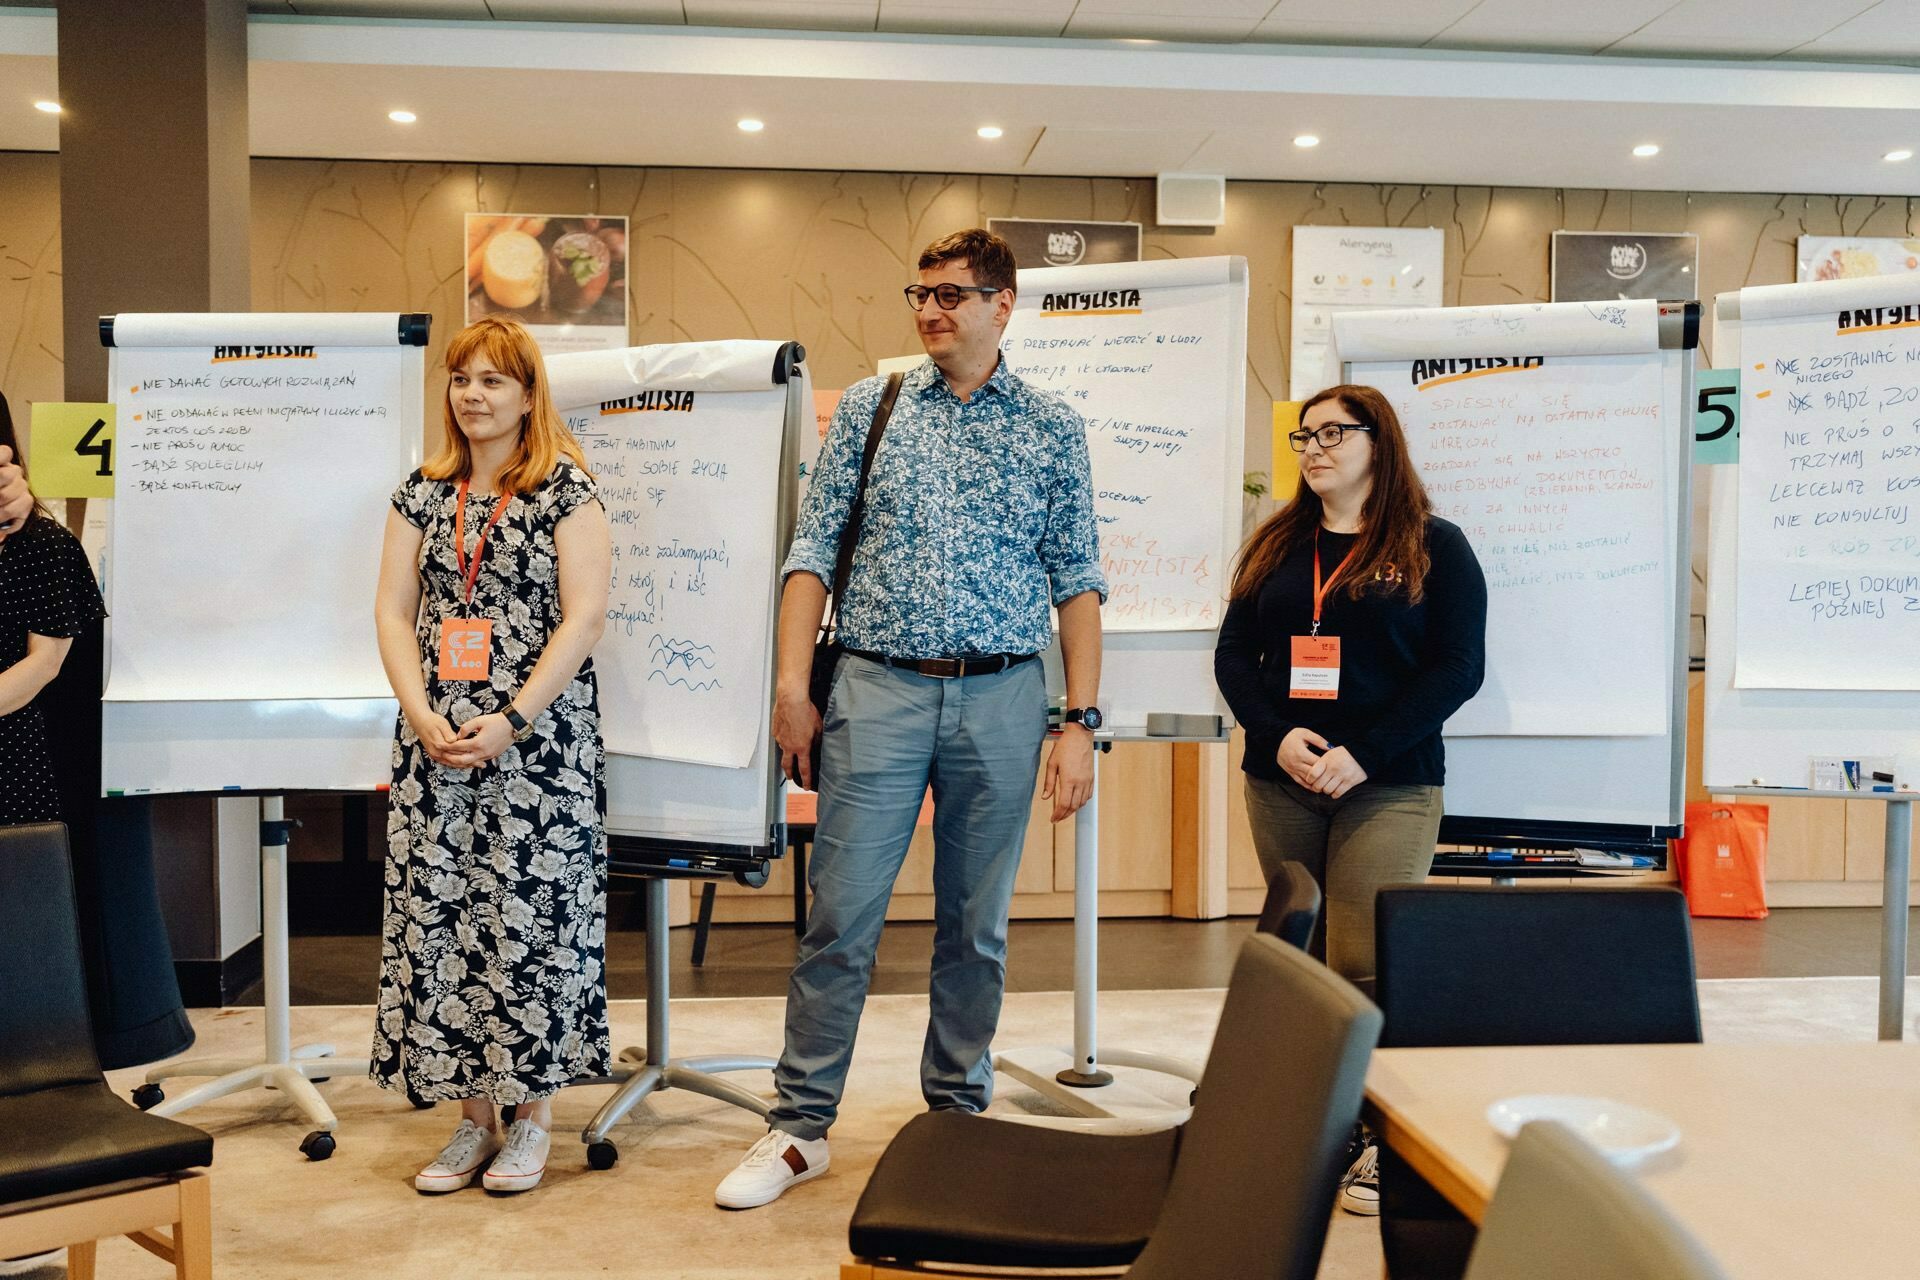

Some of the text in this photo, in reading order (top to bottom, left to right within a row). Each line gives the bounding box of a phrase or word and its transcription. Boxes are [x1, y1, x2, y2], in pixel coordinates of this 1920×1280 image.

[1042, 288, 1142, 312] ANTYLISTA
[1810, 343, 1897, 371] ZOSTAWIAĆ
[143, 379, 166, 390] NIE
[168, 373, 212, 388] DAWAĆ
[1796, 369, 1854, 385] NICZEGO
[146, 409, 166, 421] NIE
[170, 406, 219, 418] ODDAWAĆ
[74, 418, 113, 476] 4
[142, 442, 162, 451] NIE
[1784, 431, 1811, 449] NIE
[640, 461, 681, 476] SOBIE
[1790, 449, 1864, 471] TRZYMAJ
[1774, 513, 1802, 529] NIE
[630, 542, 651, 558] nie
[1789, 579, 1851, 602] LEPIEJ
[448, 631, 485, 649] CZ
